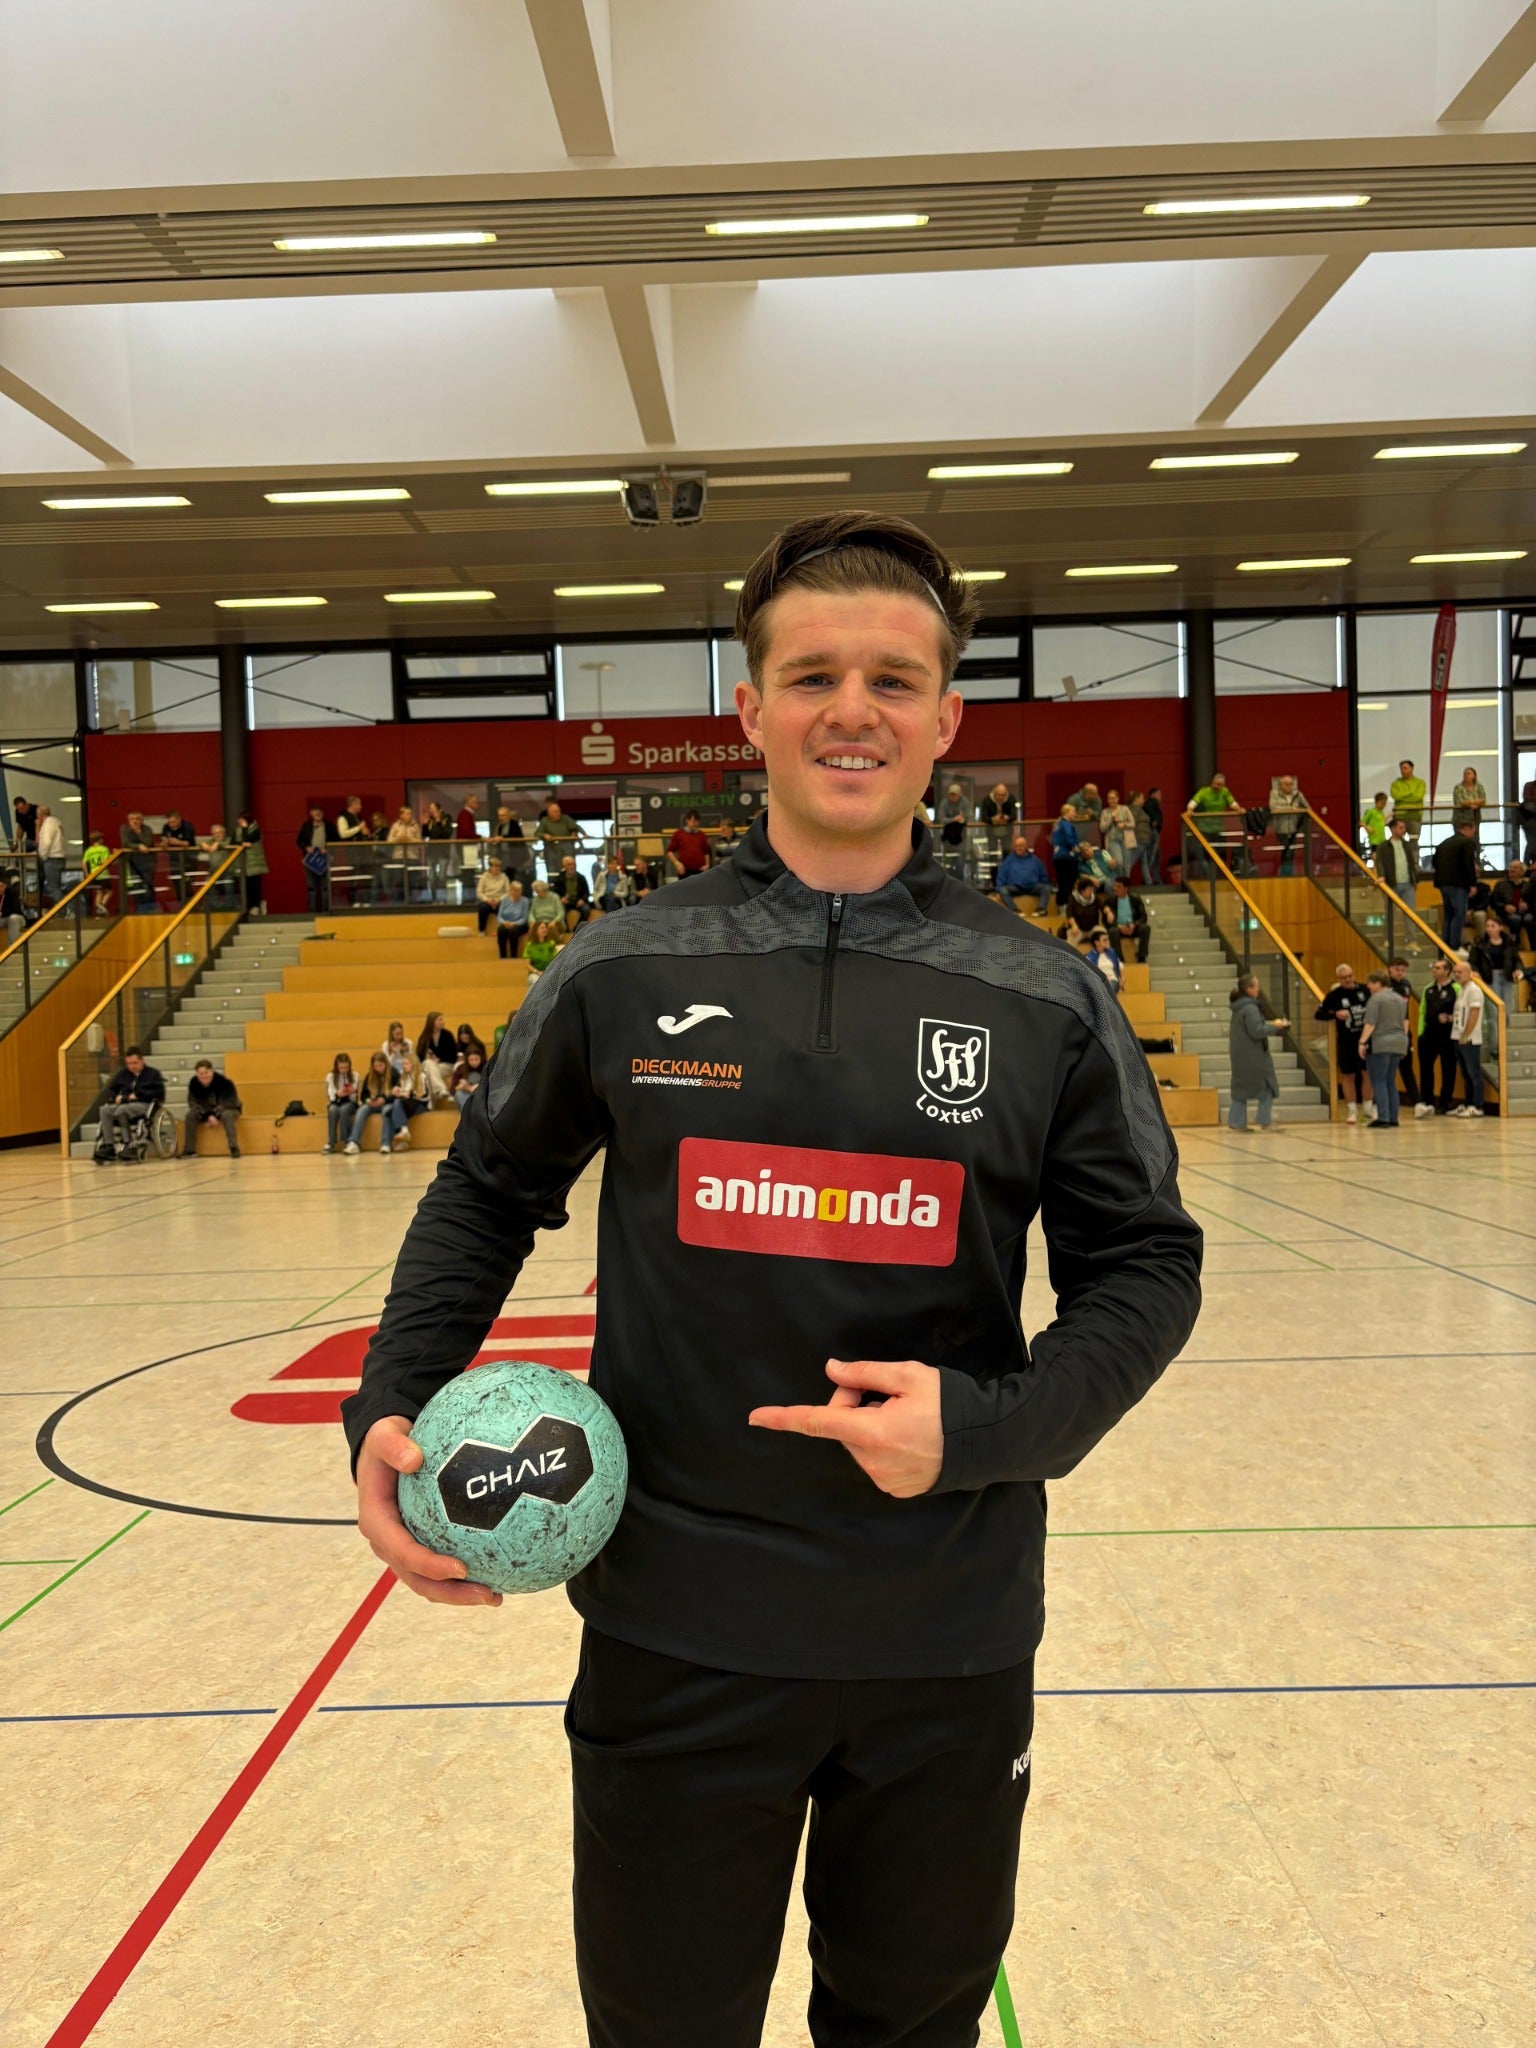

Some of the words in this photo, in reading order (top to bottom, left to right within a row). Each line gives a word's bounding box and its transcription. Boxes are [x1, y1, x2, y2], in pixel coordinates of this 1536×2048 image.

[631, 1058, 743, 1079] DIECKMANN
[631, 1075, 742, 1090] UNTERNEHMENSGRUPPE
[915, 1093, 984, 1125] Loxten
[694, 1168, 941, 1228] animonda
[466, 1447, 567, 1500] CHAIZ
